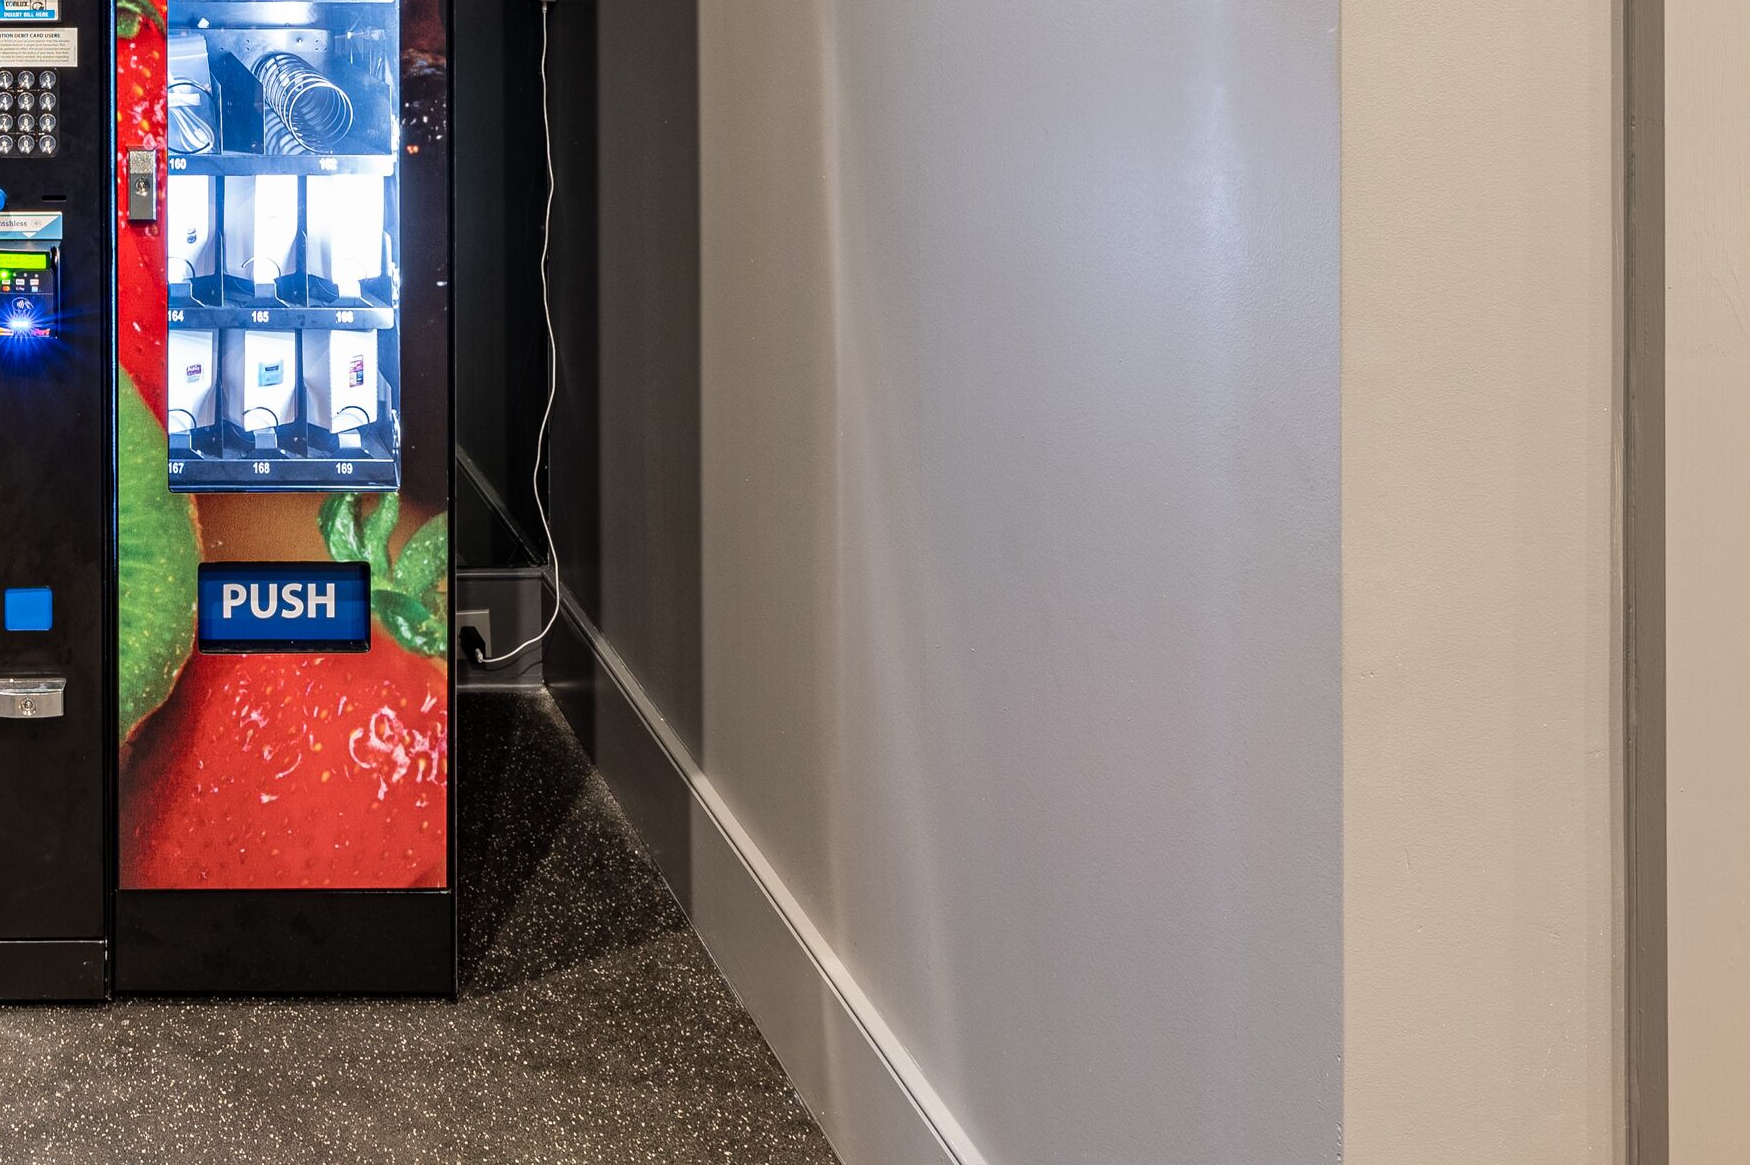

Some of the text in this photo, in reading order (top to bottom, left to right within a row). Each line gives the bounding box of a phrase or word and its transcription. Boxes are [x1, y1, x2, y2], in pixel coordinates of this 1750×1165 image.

[169, 158, 186, 170] 160
[167, 310, 184, 322] 164
[251, 310, 269, 322] 165
[168, 462, 184, 474] 167
[253, 462, 270, 474] 168
[336, 462, 353, 474] 169
[223, 583, 335, 619] PUSH
